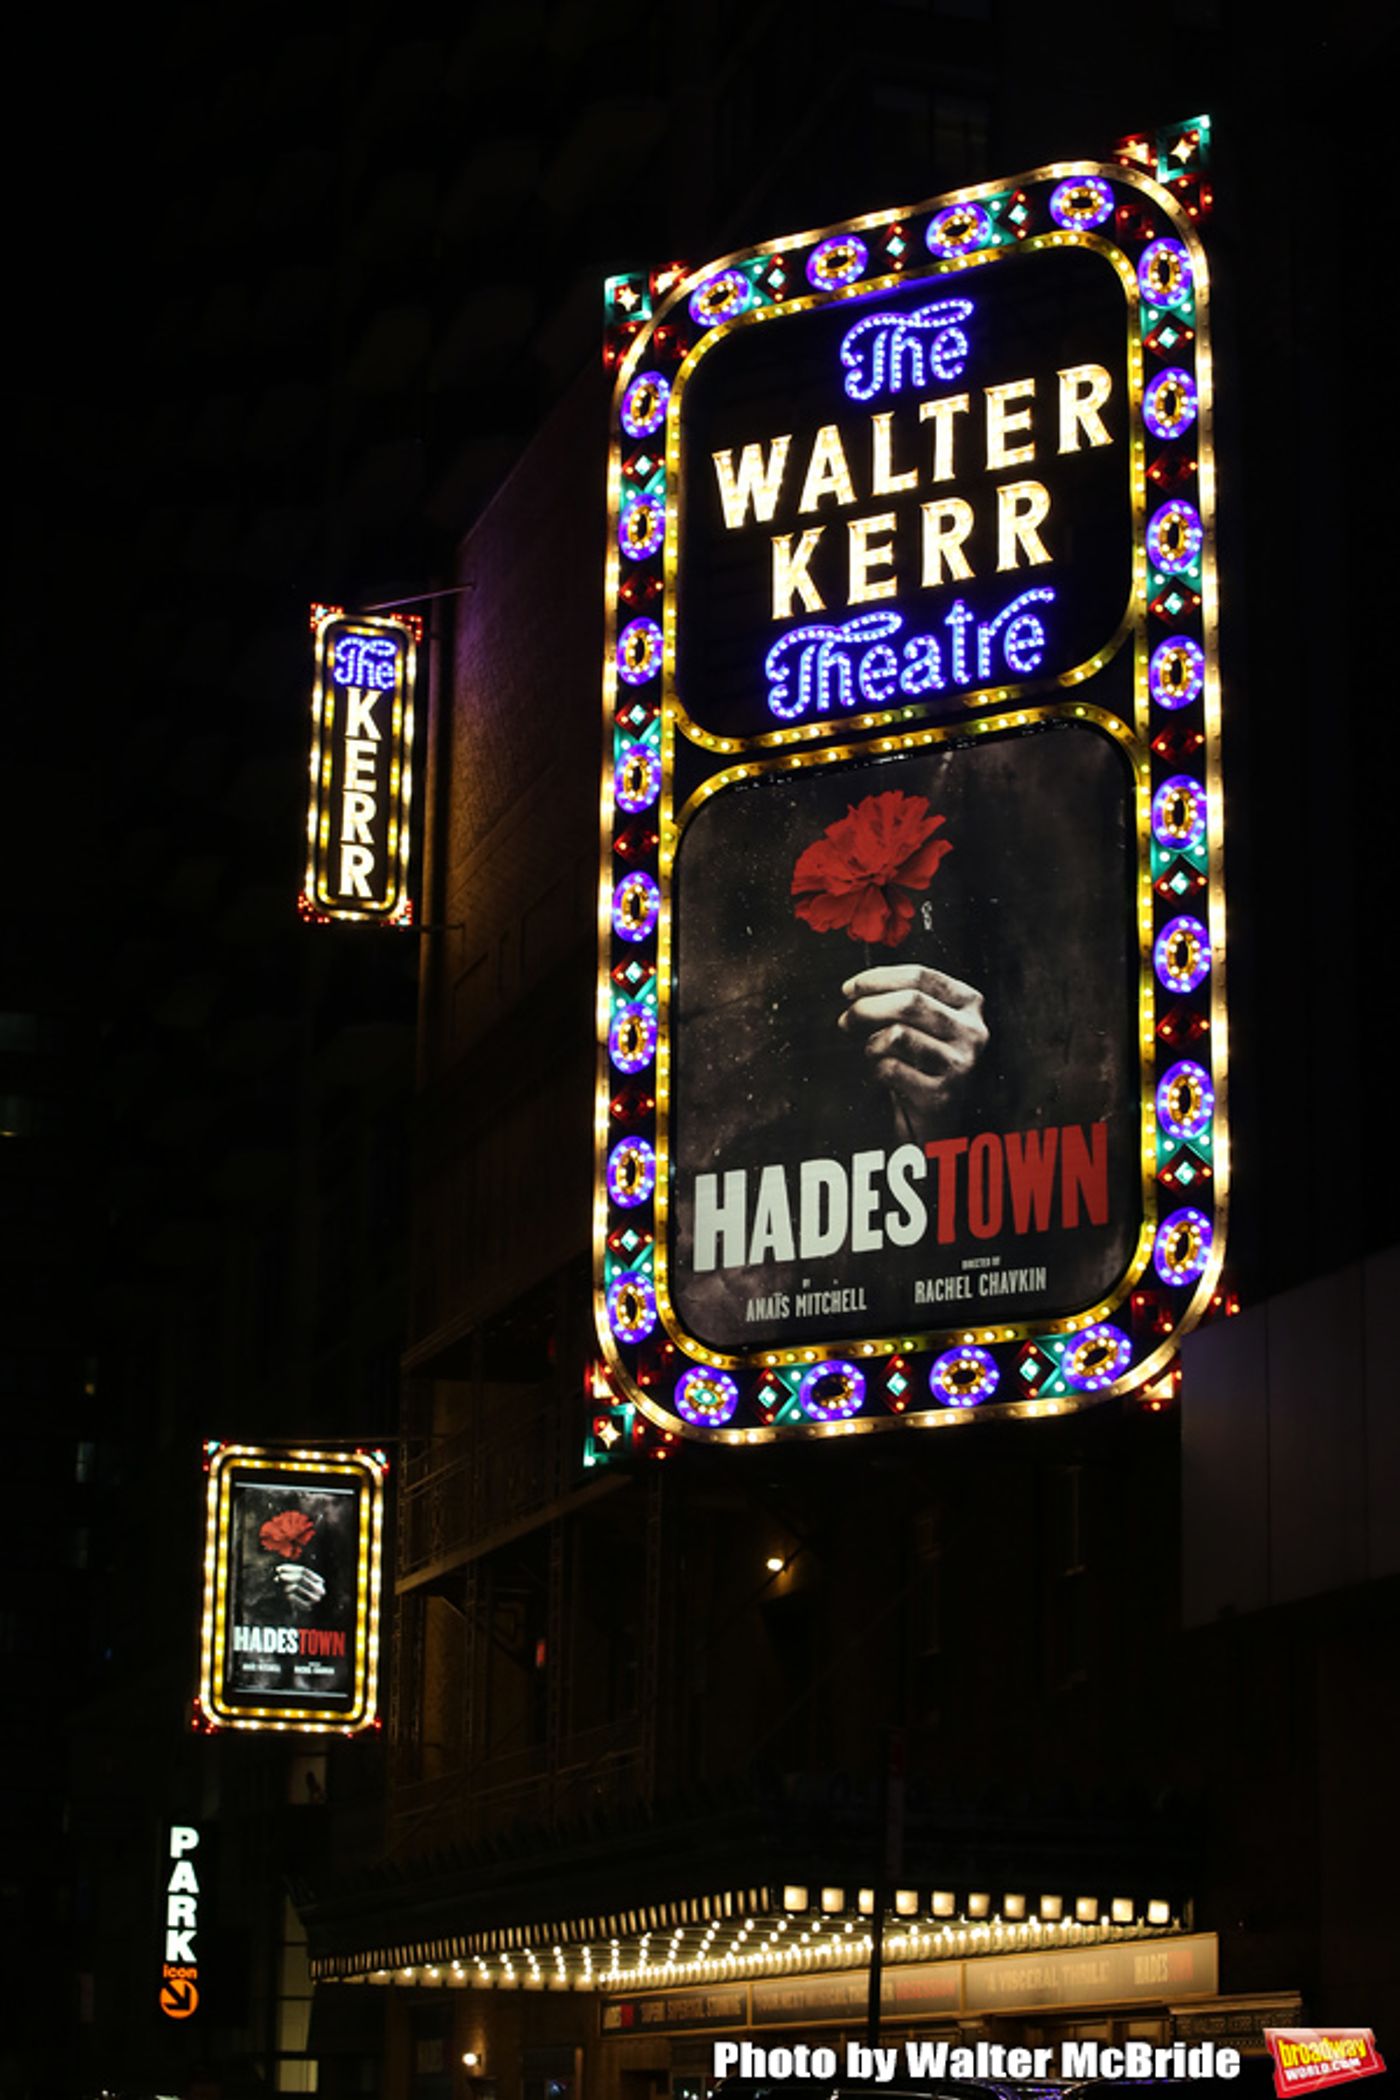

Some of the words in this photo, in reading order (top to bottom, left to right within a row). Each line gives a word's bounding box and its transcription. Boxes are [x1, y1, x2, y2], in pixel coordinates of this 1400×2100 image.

[840, 299, 974, 400] The
[712, 363, 1114, 530] WALTER
[771, 480, 1053, 620] KERR
[333, 635, 398, 690] The
[765, 586, 1056, 719] Theatre
[338, 686, 383, 899] KERR
[693, 1122, 1109, 1272] HADESTOWN
[795, 1288, 867, 1317] MITCHELL
[914, 1275, 973, 1304] RACHEL
[979, 1267, 1047, 1297] CHAVKIN
[233, 1626, 345, 1657] HADESTOWN
[164, 1825, 201, 1964] PARK
[162, 1962, 198, 1980] icon
